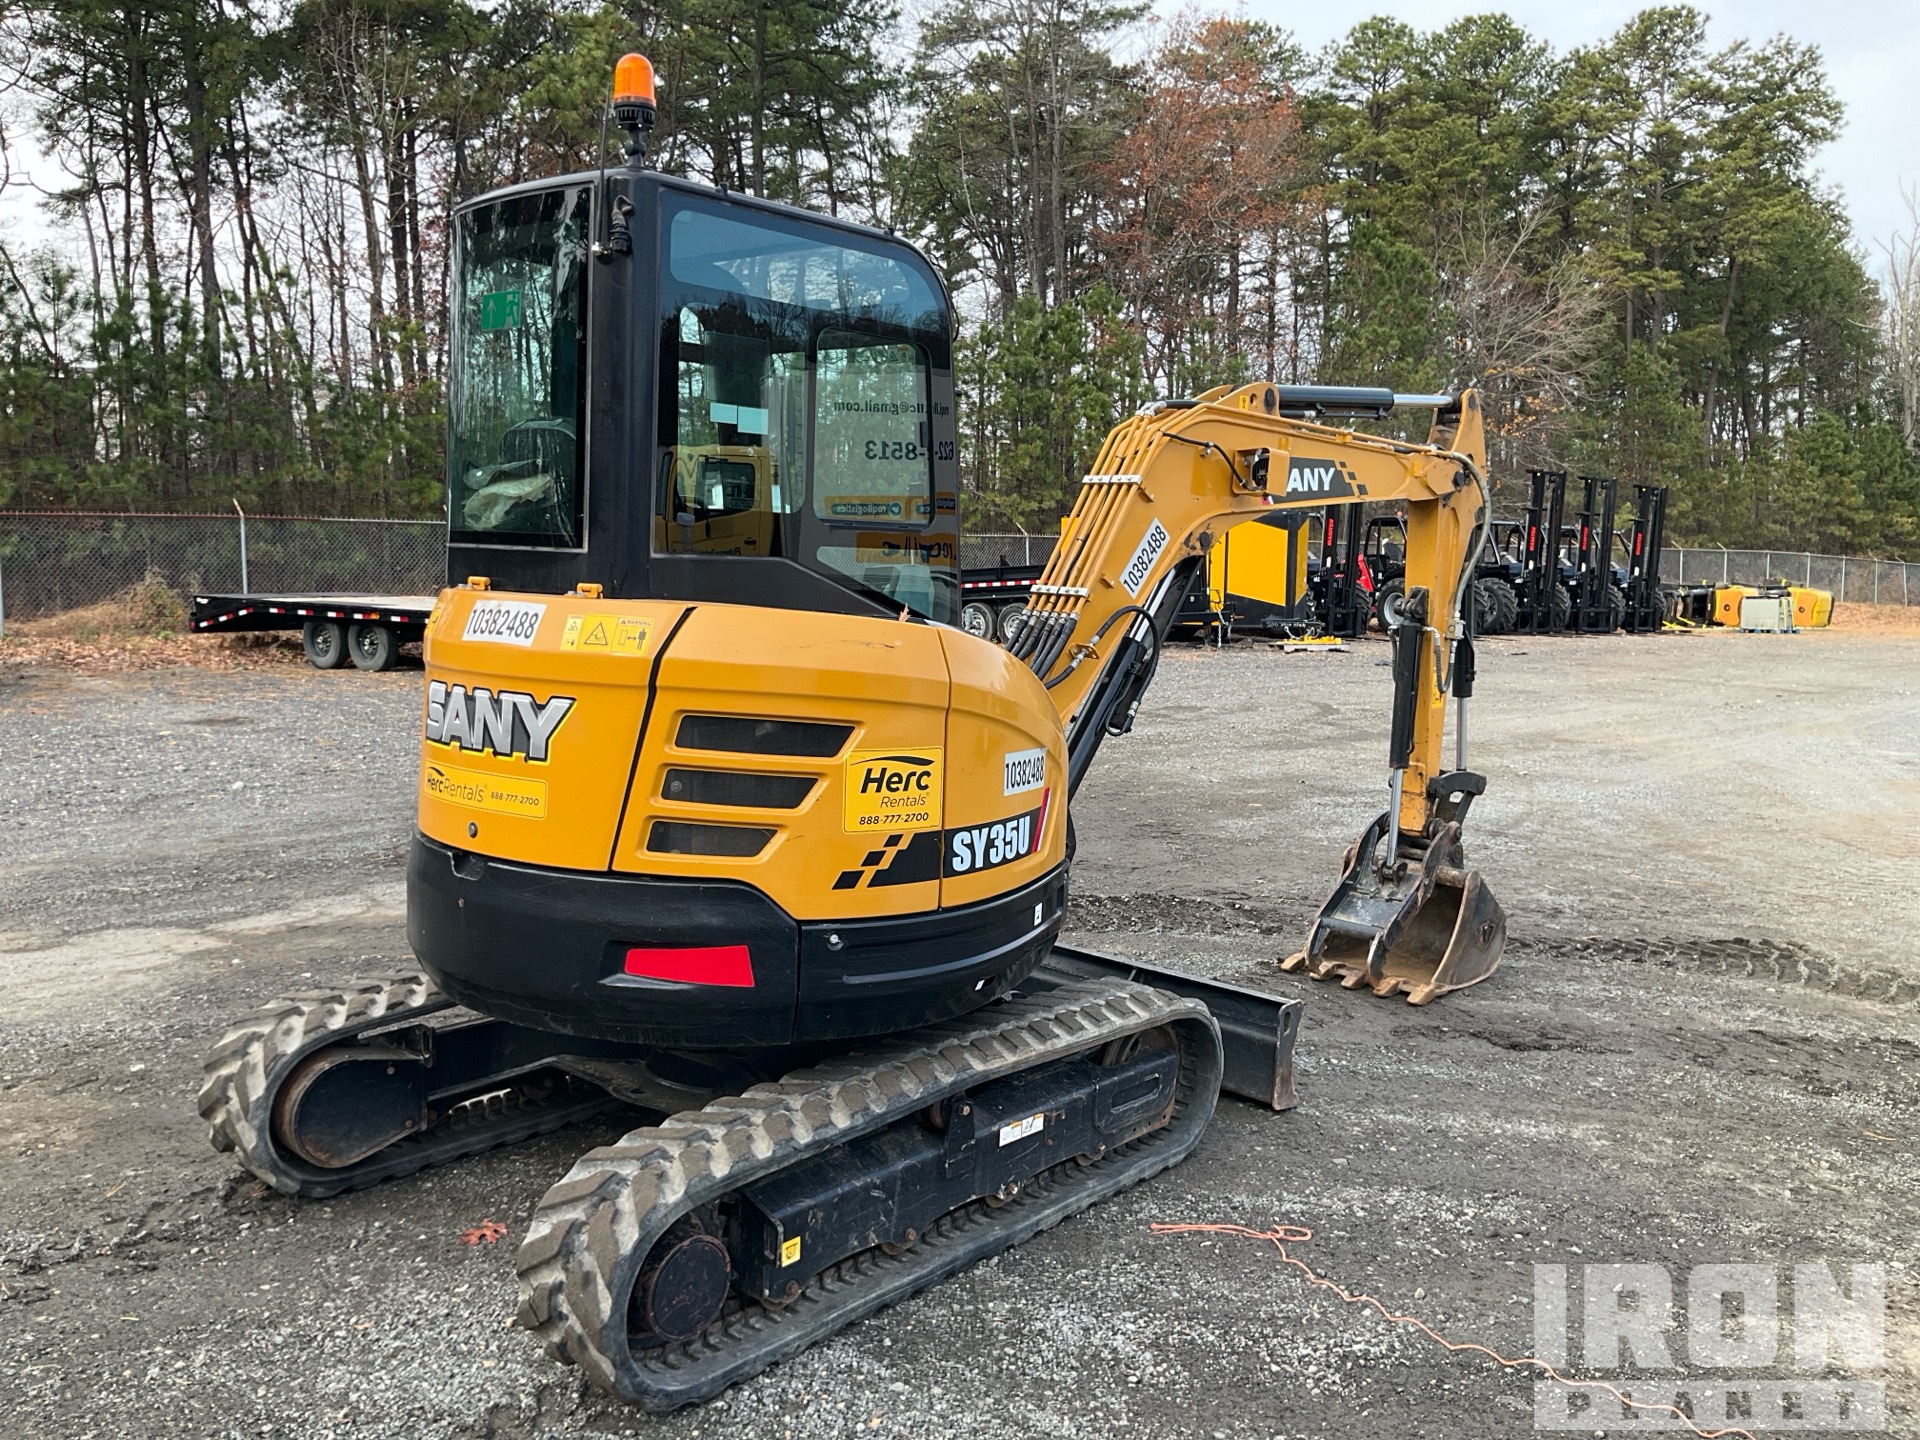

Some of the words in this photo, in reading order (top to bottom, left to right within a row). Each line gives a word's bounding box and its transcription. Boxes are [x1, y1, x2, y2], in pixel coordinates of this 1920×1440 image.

[1286, 468, 1336, 492] ANY
[1123, 525, 1167, 593] 10382488
[466, 609, 540, 640] 10382488
[425, 679, 577, 764] SANY
[860, 767, 932, 794] Herc
[1005, 756, 1045, 789] 10382488
[490, 791, 540, 806] 888-777-2700
[880, 794, 927, 809] Rentals
[859, 812, 930, 826] 888-777-2700
[952, 815, 1031, 872] SY35U
